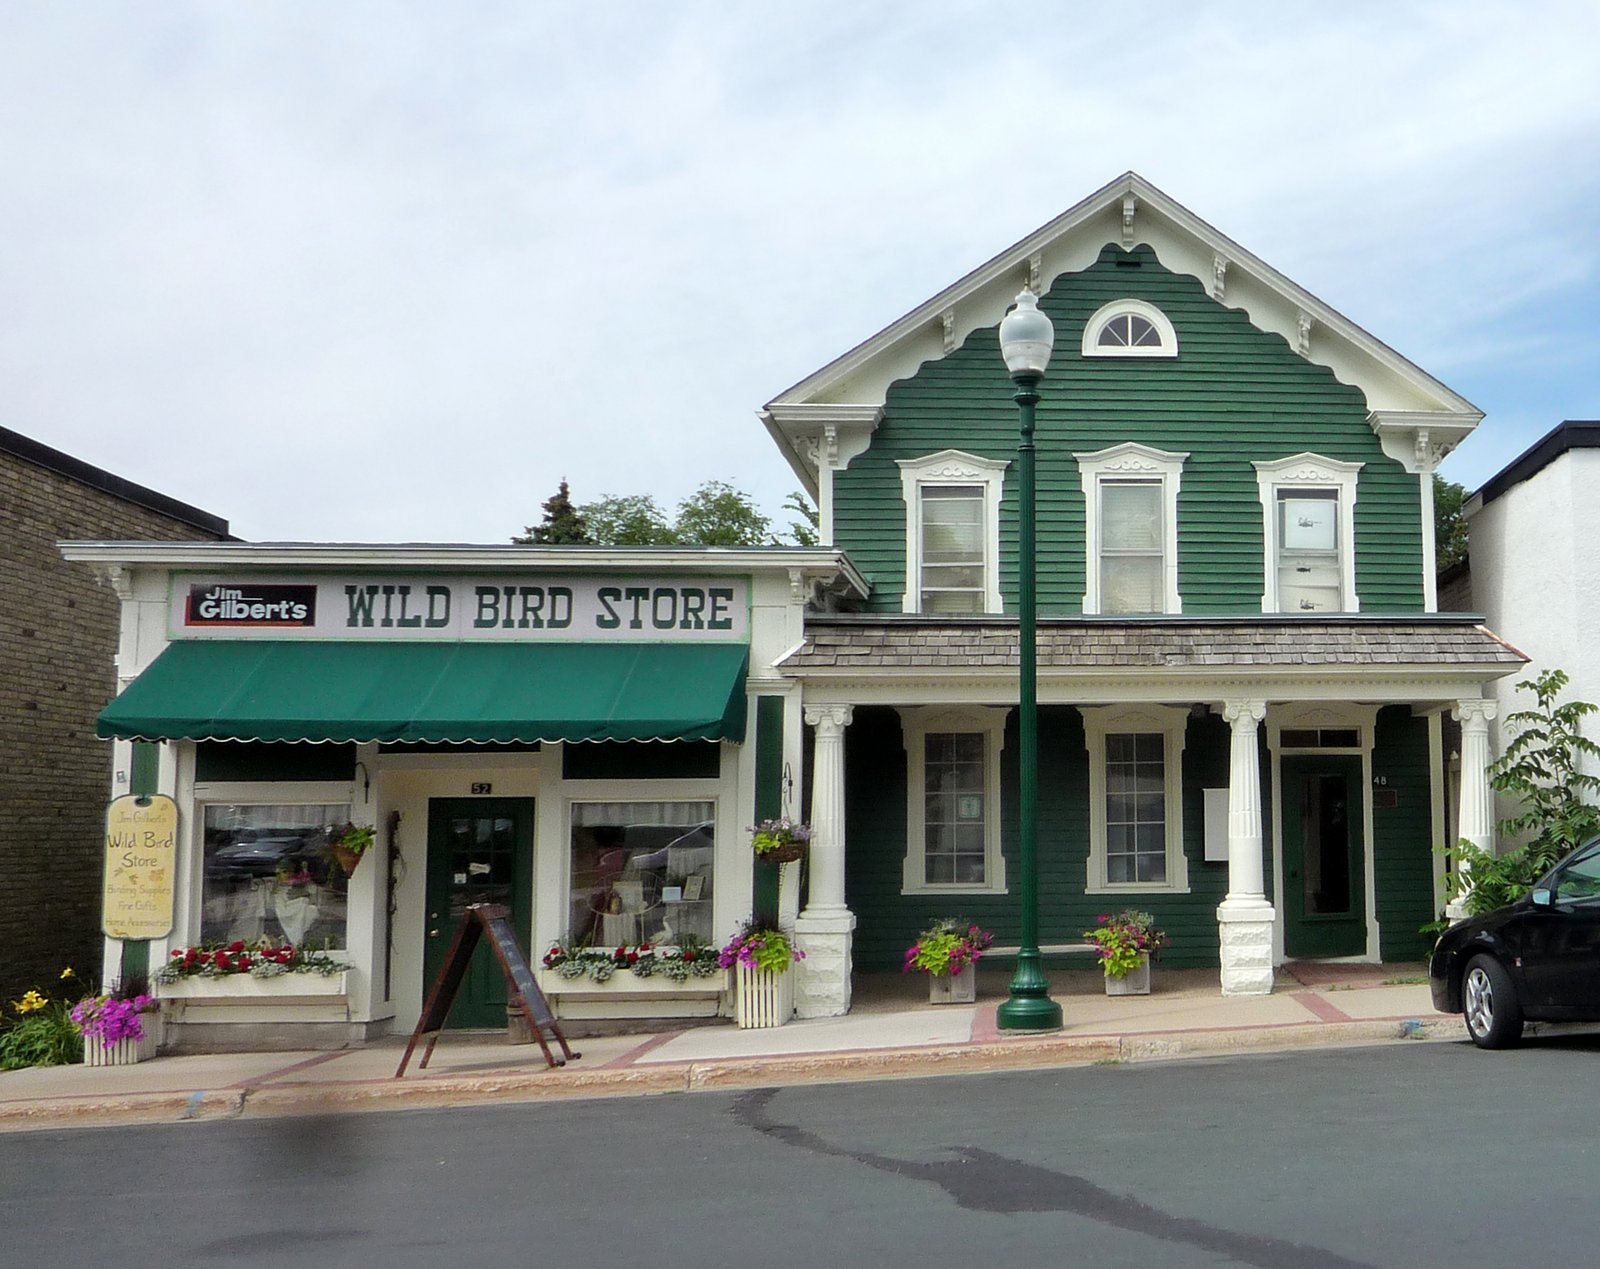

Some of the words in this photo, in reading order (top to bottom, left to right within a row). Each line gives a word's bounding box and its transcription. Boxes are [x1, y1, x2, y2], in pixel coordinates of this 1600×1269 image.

[205, 587, 244, 600] Jim
[199, 601, 307, 620] Gilbert's
[344, 584, 451, 629] WILD
[473, 585, 573, 629] BIRD
[595, 587, 734, 631] STORE
[473, 783, 489, 794] 52
[1373, 776, 1387, 785] 48
[107, 831, 136, 849] Wild
[143, 831, 174, 849] Bird
[121, 851, 158, 868] Store
